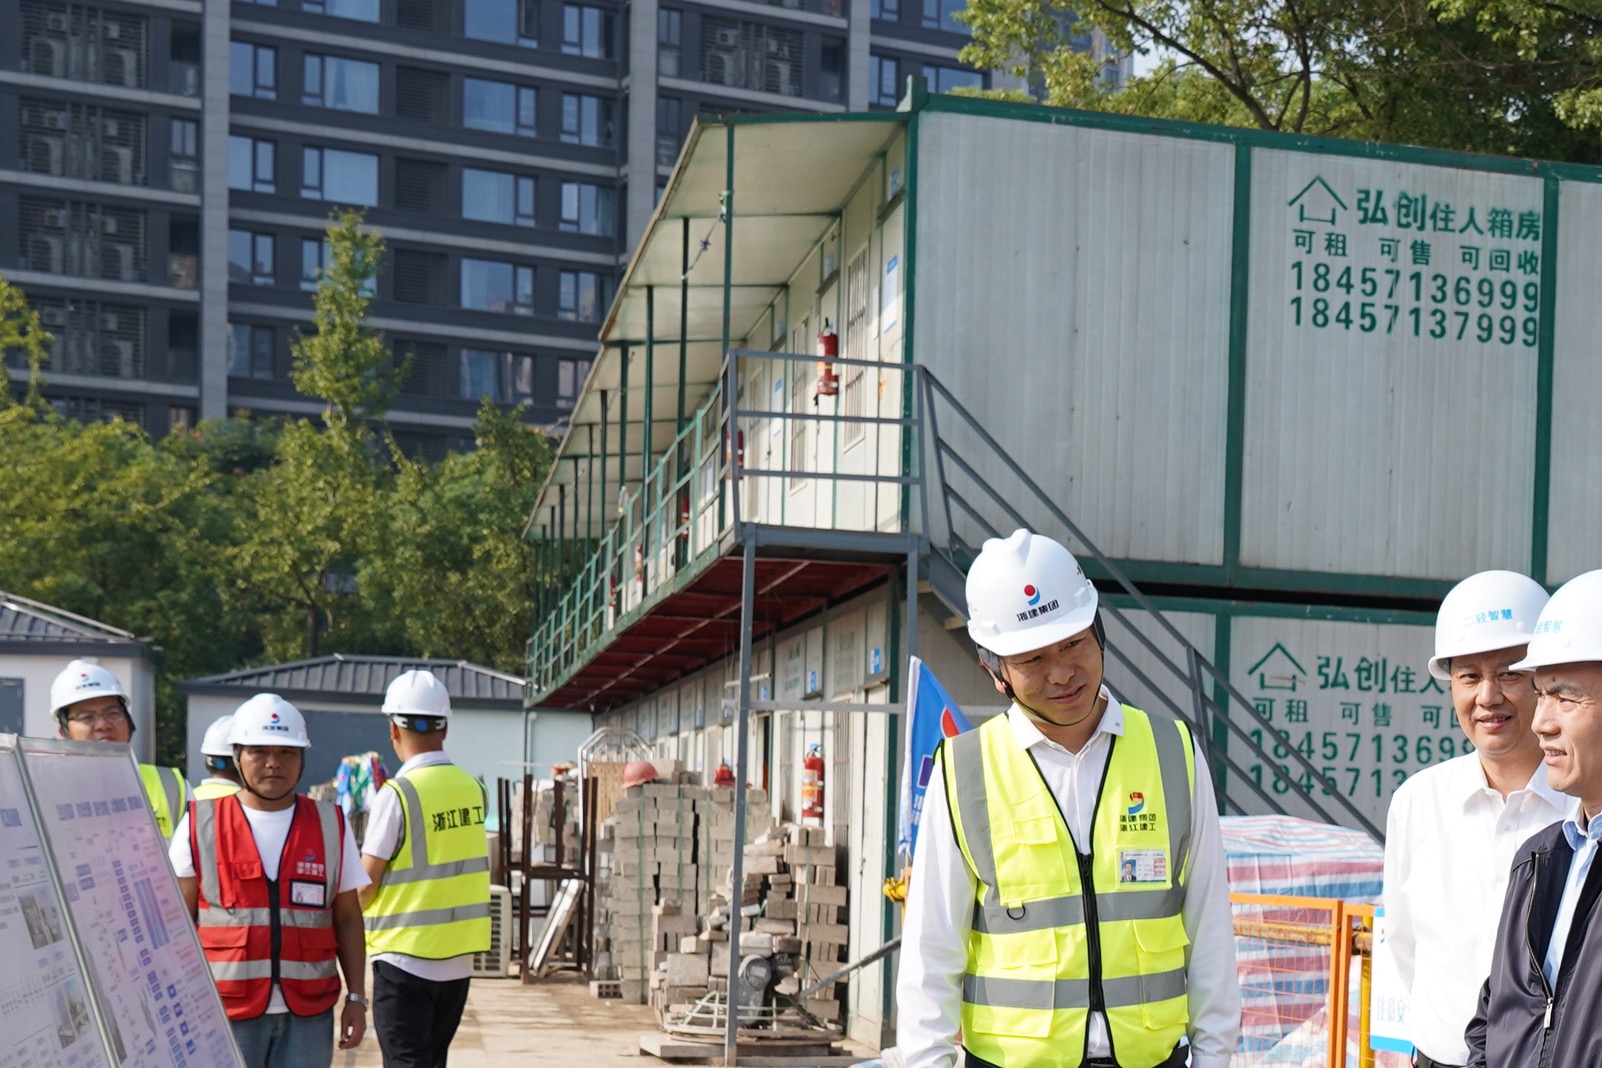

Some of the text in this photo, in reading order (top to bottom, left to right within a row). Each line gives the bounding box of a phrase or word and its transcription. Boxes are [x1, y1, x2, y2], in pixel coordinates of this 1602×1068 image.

[1357, 188, 1540, 241] 弘创住人箱房
[1293, 229, 1538, 275] 可租 可售 可回收
[1291, 261, 1538, 312] 18457136999
[1290, 296, 1537, 347] 18457137999
[1017, 599, 1059, 622] 浙建集团
[1316, 655, 1452, 694] 弘创住人
[1252, 697, 1309, 723] 可租
[1340, 702, 1393, 728] 可售
[432, 806, 484, 832] 浙江建工
